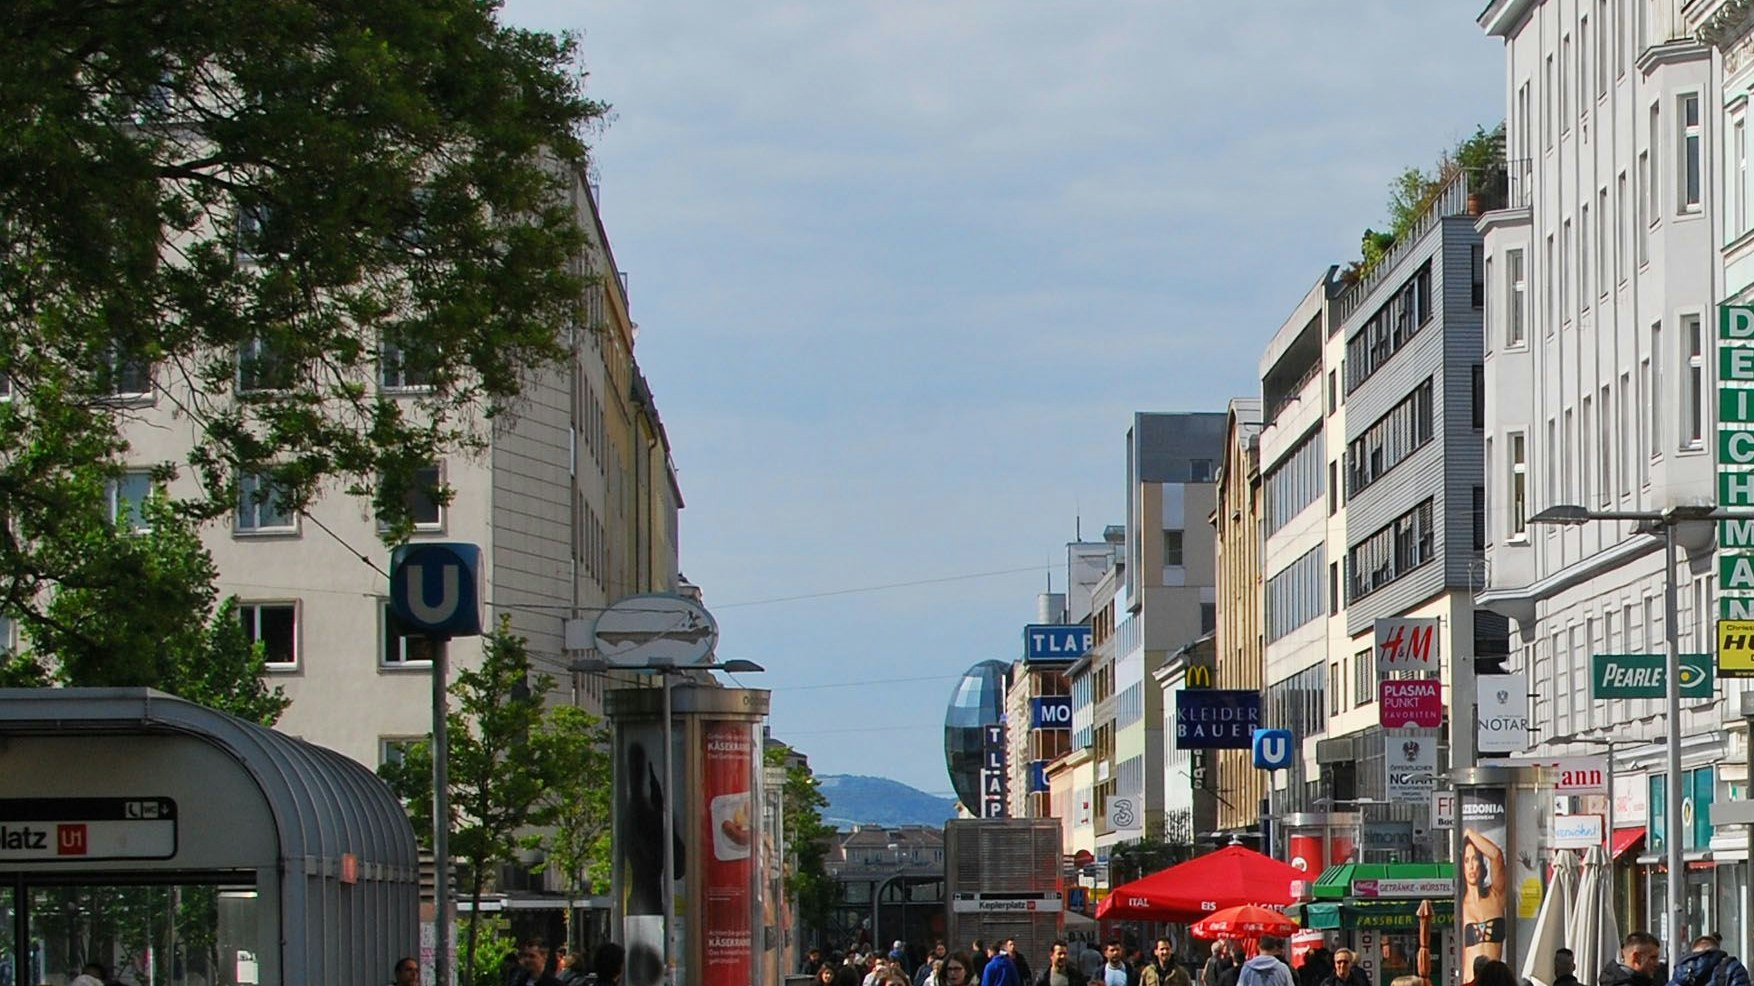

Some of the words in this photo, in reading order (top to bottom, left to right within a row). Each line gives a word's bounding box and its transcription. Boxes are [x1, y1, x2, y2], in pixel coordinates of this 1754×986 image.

[407, 565, 458, 624] U
[1380, 625, 1432, 662] H&M
[1602, 663, 1662, 688] PEARLE
[1385, 686, 1435, 696] PLASMA
[1385, 697, 1419, 708] PUNKT
[1178, 708, 1258, 721] KLEIDER
[1478, 718, 1528, 731] NOTAR
[1262, 738, 1285, 764] U
[0, 827, 47, 849] latz
[61, 832, 82, 847] U1
[979, 901, 1025, 910] Keplerplatz
[1201, 901, 1216, 911] EIS
